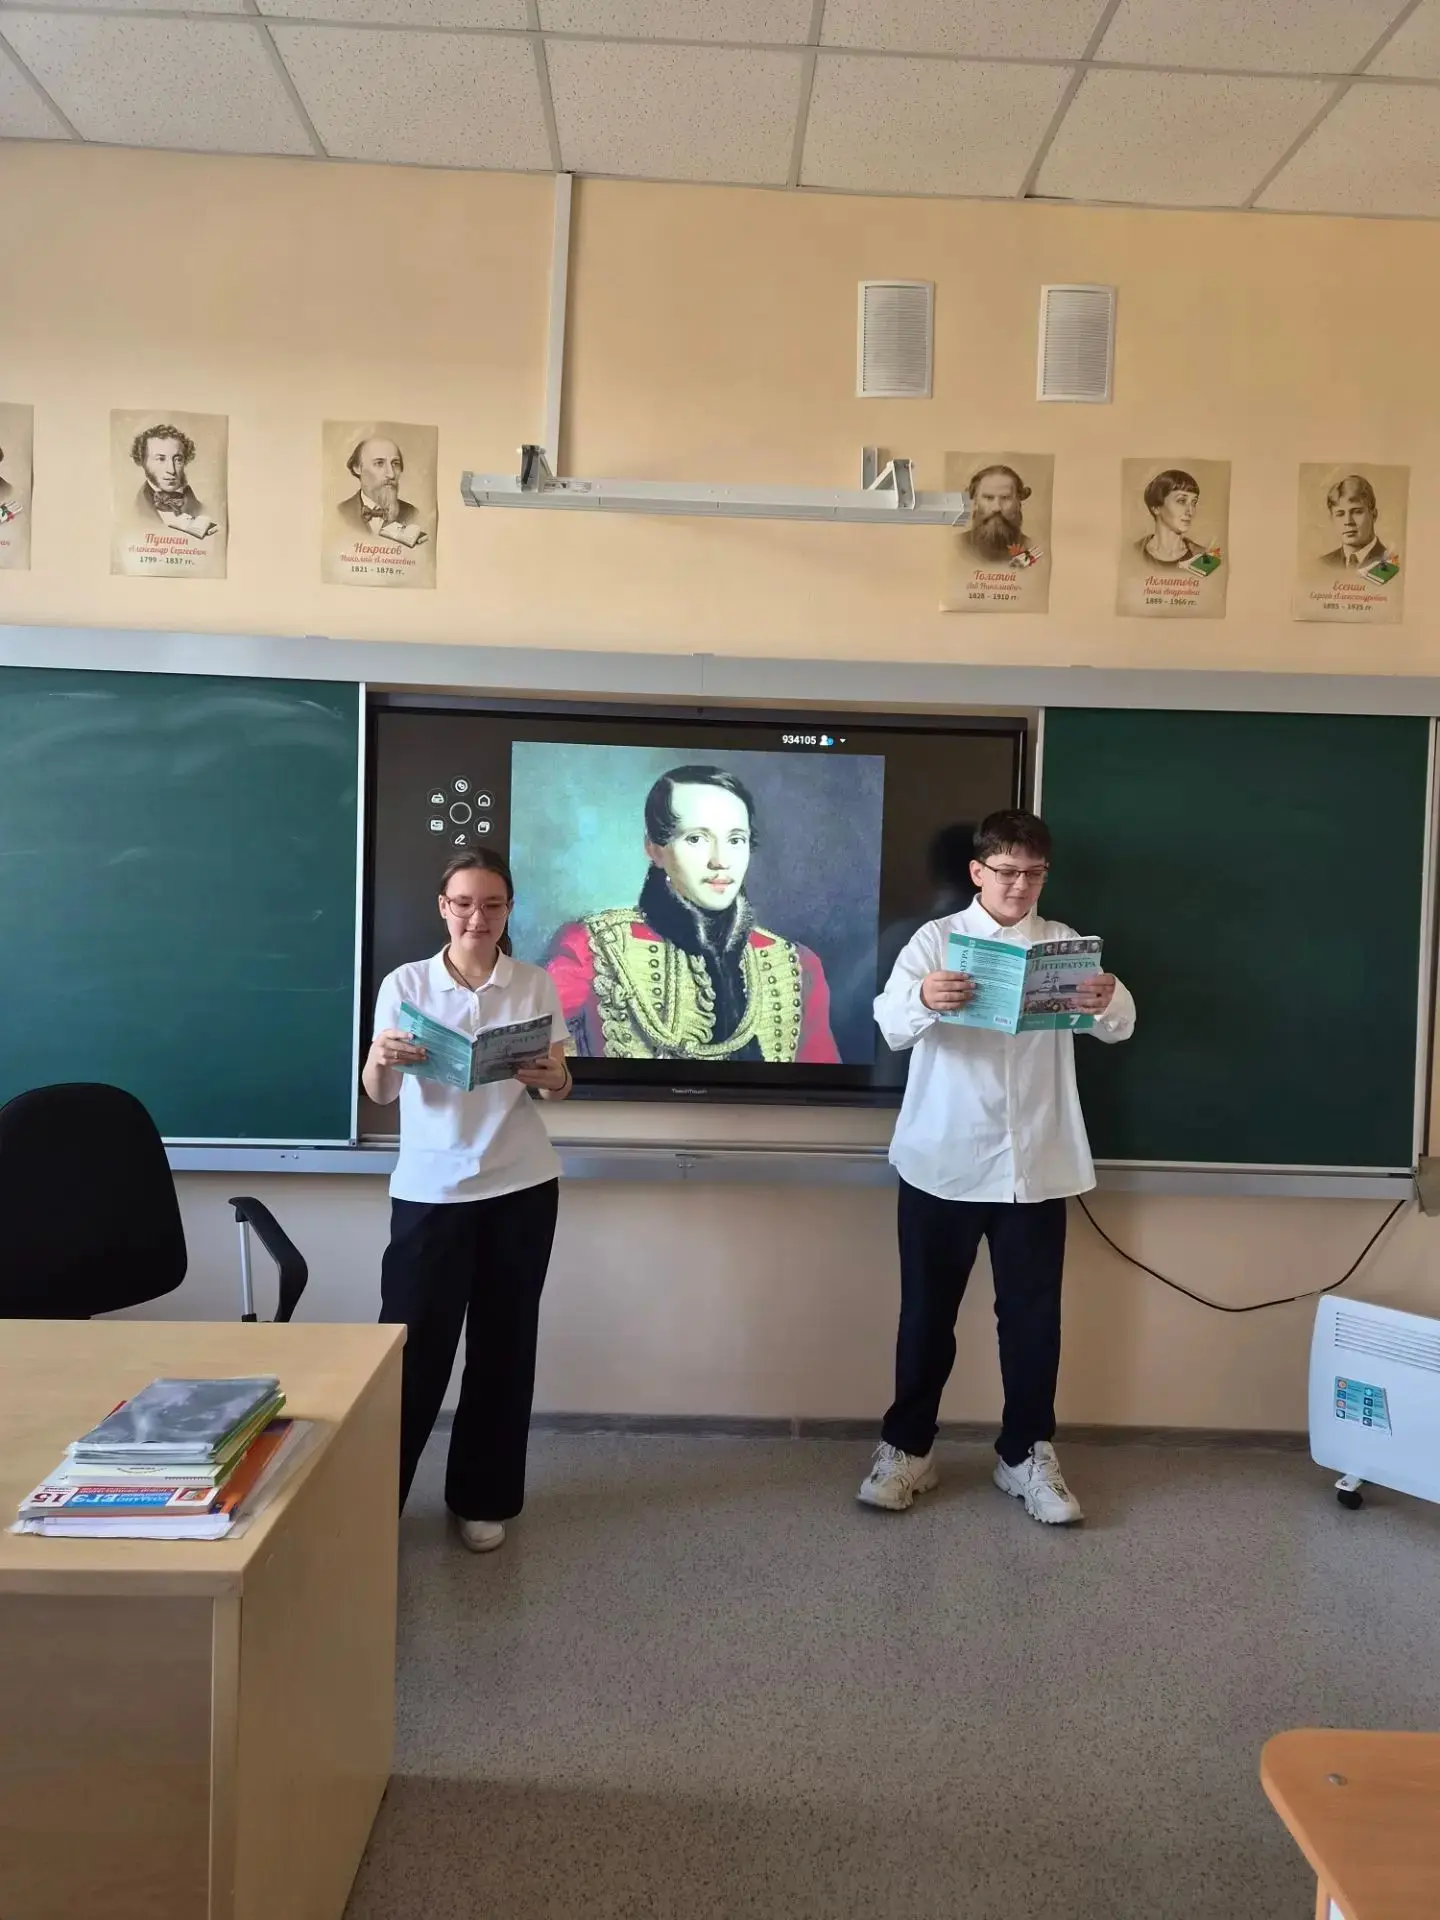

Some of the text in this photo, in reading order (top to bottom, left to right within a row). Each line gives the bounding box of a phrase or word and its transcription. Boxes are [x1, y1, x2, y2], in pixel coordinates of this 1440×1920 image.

[144, 533, 189, 546] Пушкин
[354, 542, 402, 556] Некрасов
[140, 556, 157, 564] 1799
[974, 569, 1017, 581] Толстой
[1145, 576, 1200, 588] Ахматова
[1332, 580, 1366, 592] Есенин
[782, 734, 817, 745] 934105
[1068, 1014, 1080, 1026] 7
[32, 1493, 61, 1503] 15
[71, 1493, 118, 1503] ЕГЭ
